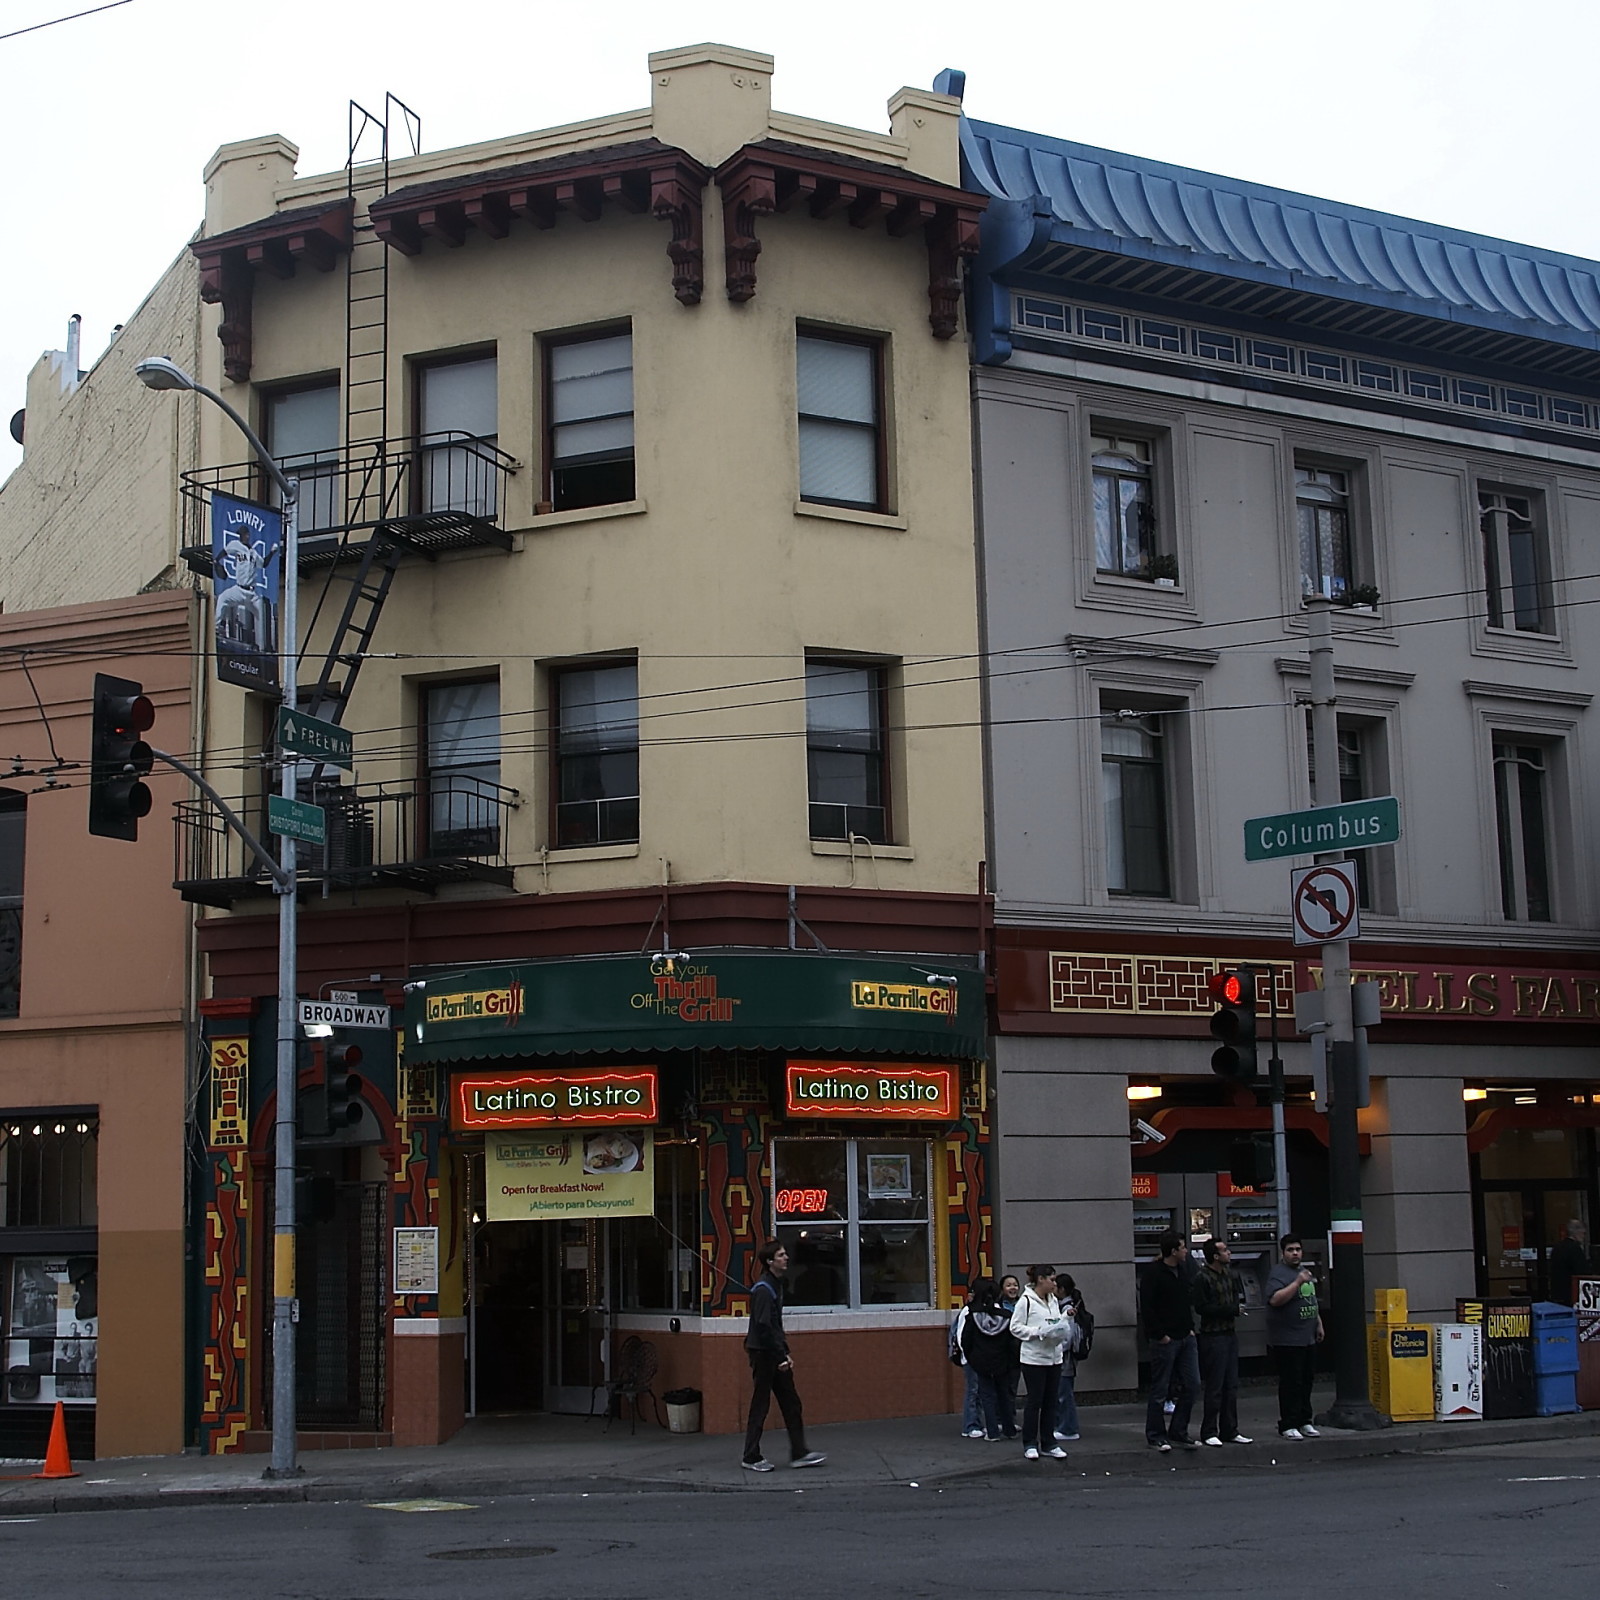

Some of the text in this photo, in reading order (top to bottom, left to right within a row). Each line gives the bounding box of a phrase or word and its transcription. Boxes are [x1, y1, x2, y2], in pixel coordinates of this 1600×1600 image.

[227, 509, 266, 532] LOWRY
[229, 659, 260, 677] cingular
[301, 727, 352, 758] FREEWAY
[1260, 815, 1381, 849] Columbus
[676, 965, 709, 982] your
[334, 992, 349, 1002] 600
[653, 974, 717, 1001] Thrill
[855, 984, 875, 1006] La
[878, 985, 928, 1010] Parrilla
[428, 981, 522, 1022] La Parrilla Grill
[630, 993, 653, 1010] Off
[653, 998, 679, 1015] The
[304, 1005, 386, 1025] BROADWAY
[474, 1085, 642, 1112] Latino Bistro
[799, 1077, 939, 1102] Latino Bistro
[501, 1182, 605, 1198] Open for Breakfast Now!
[776, 1189, 829, 1213] OPEN
[566, 1201, 585, 1212] para
[586, 1197, 635, 1211] Desayunos!
[1488, 1314, 1530, 1338] GUARDIAN
[1393, 1338, 1425, 1348] Chronicle
[1394, 1333, 1408, 1343] The
[1471, 1327, 1480, 1403] The Examiner
